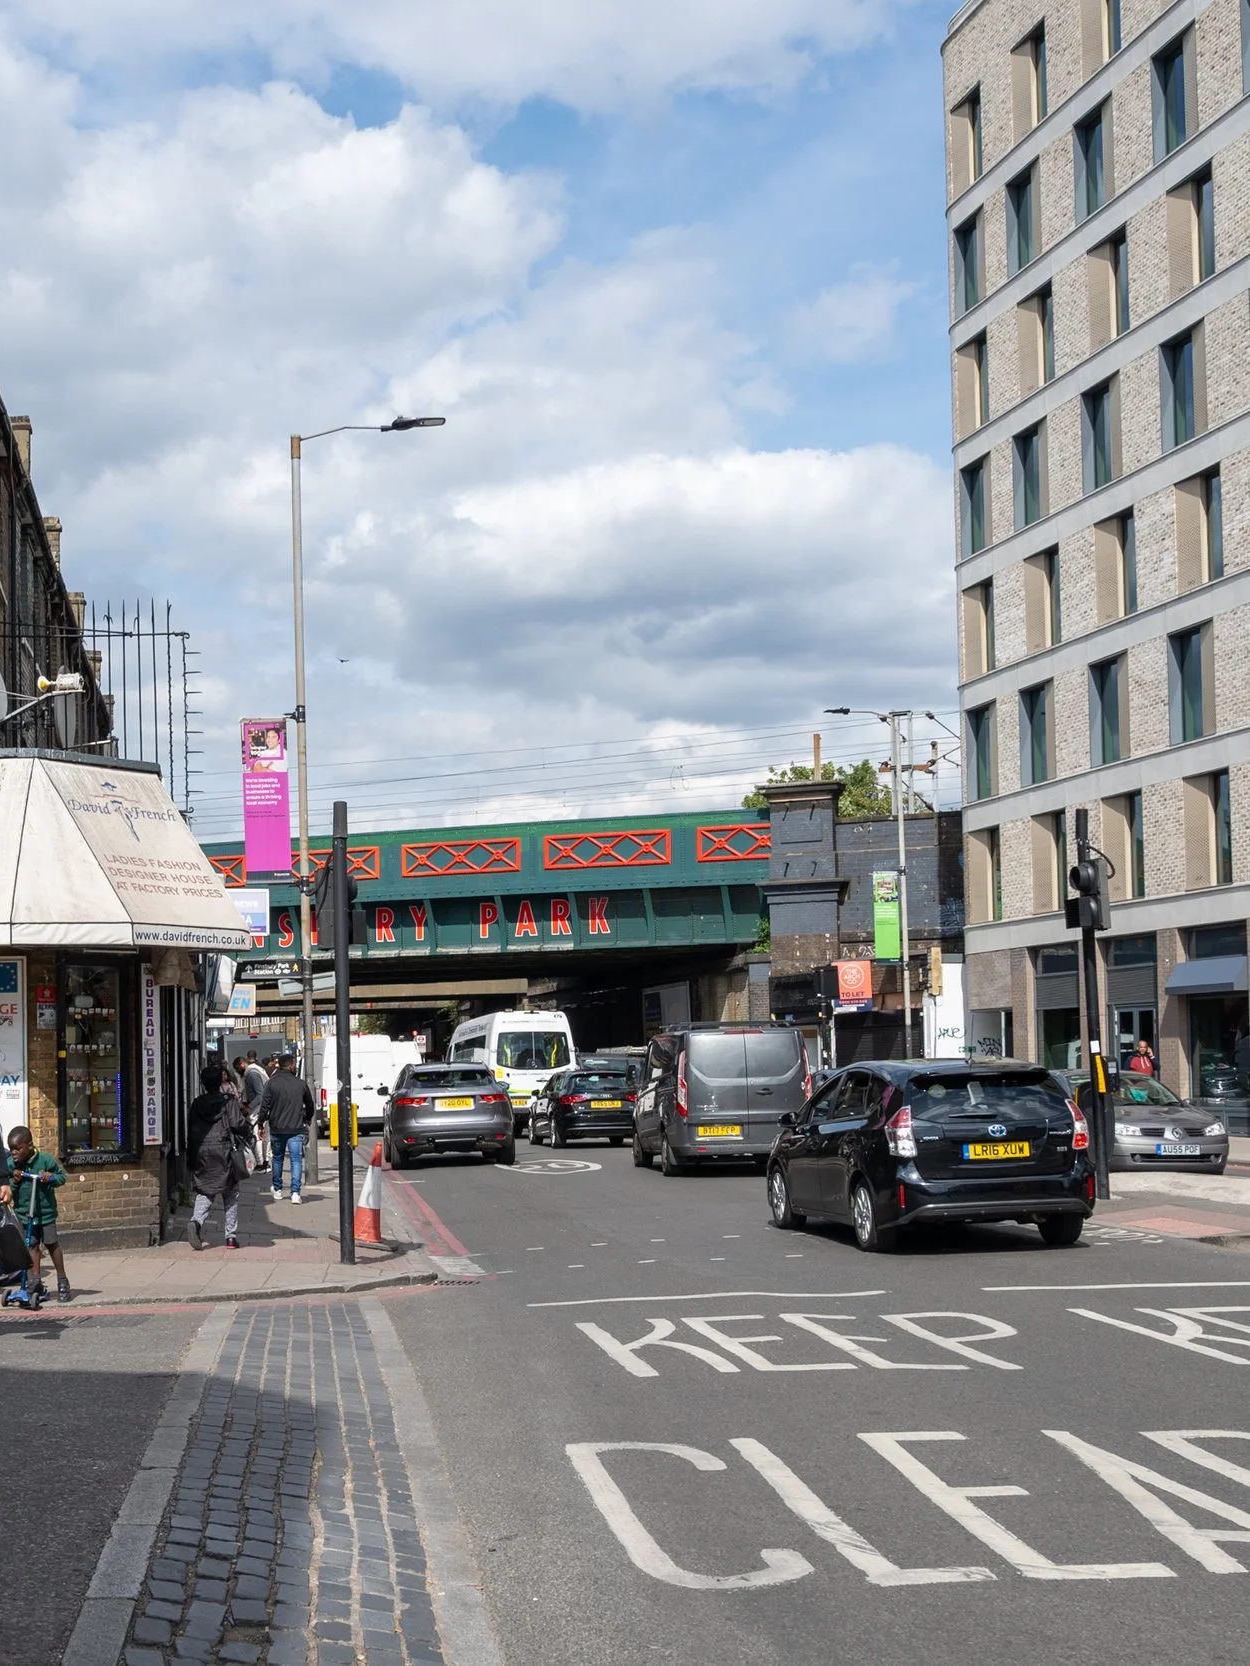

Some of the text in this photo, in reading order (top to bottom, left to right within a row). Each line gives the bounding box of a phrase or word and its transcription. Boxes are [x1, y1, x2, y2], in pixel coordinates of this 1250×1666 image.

[68, 799, 176, 822] David French
[104, 853, 202, 872] LADIES FASHION
[108, 867, 213, 885] DESIGNER HOUSE
[116, 881, 223, 898] AT FACTORY PRICES
[479, 897, 609, 939] PARK
[135, 930, 246, 946] www.davidfrench.co.uk
[146, 979, 154, 1037] BUREAU
[973, 1143, 1025, 1157] LR16 XUW
[575, 1312, 1024, 1377] KEEP
